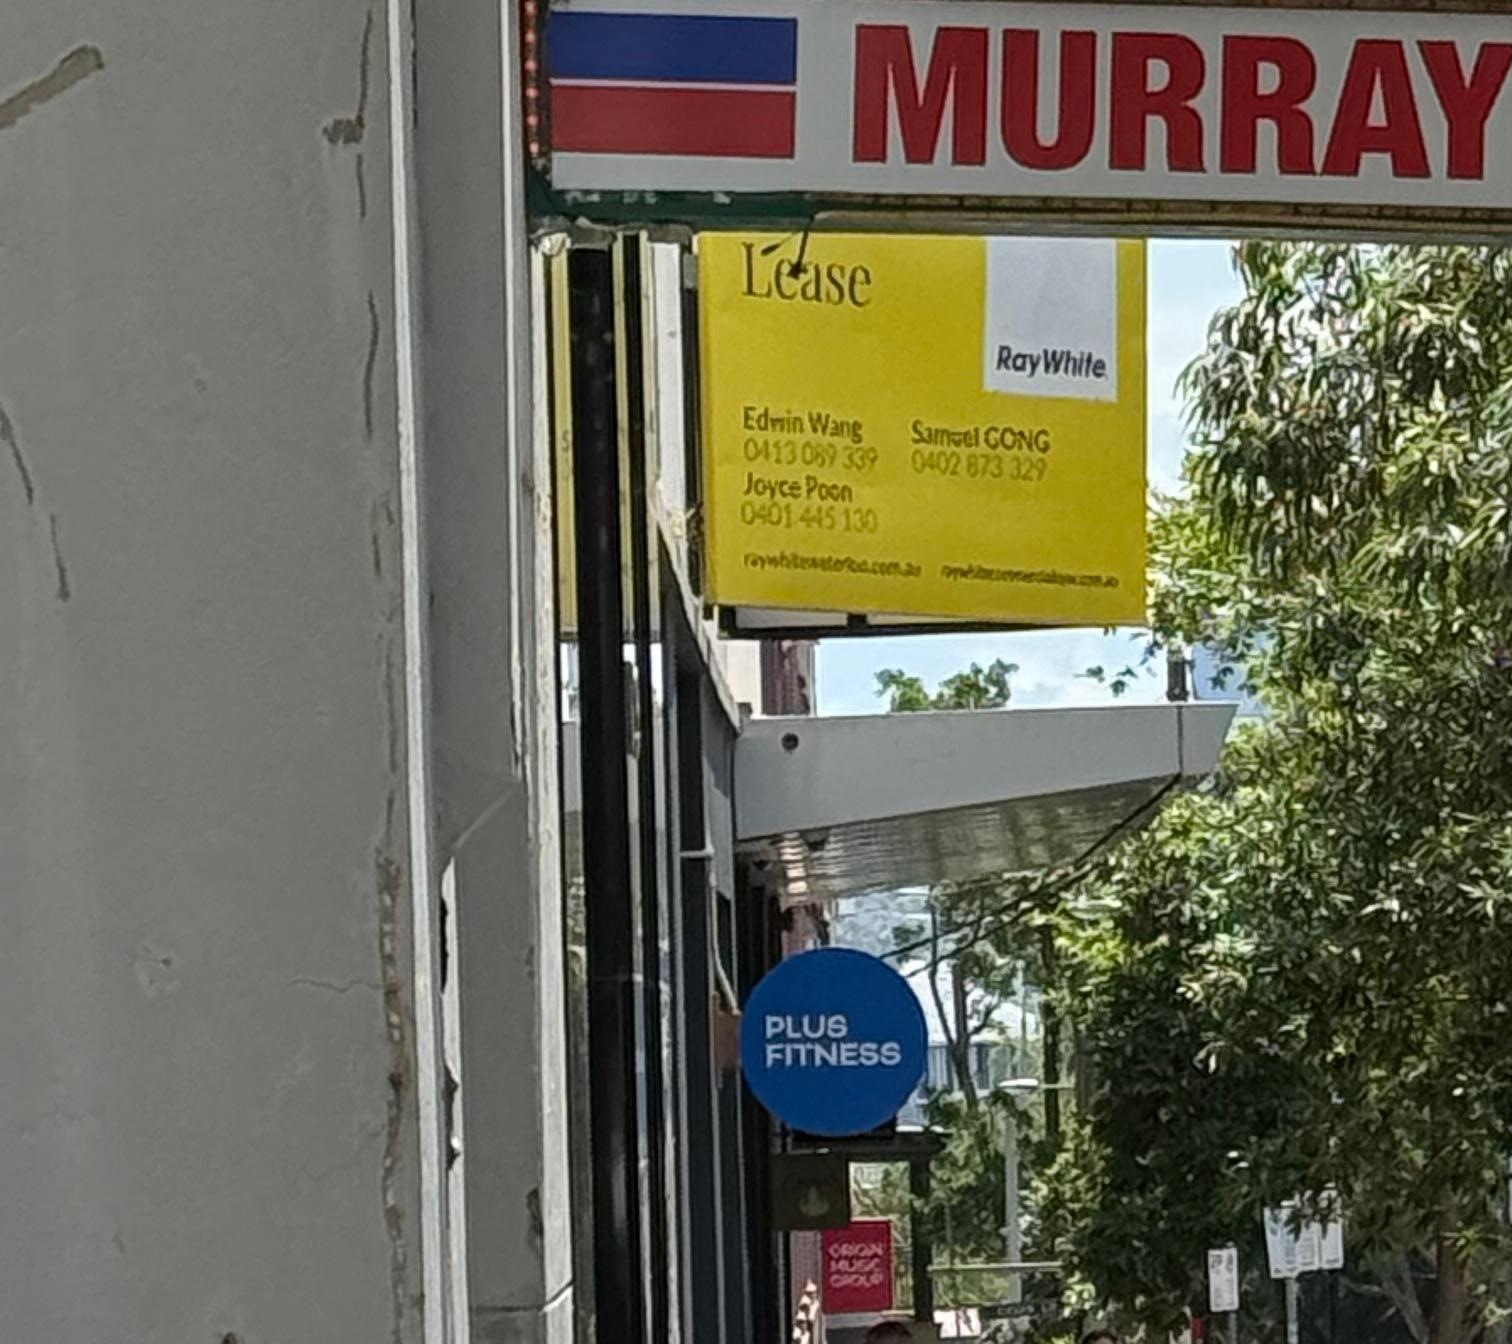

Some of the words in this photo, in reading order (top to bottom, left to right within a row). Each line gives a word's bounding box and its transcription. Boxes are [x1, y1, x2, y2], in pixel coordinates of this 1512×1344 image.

[741, 242, 872, 308] Lease
[743, 406, 805, 434] Edwin
[808, 411, 863, 445] Wang
[911, 419, 980, 448] Samuel
[983, 425, 1051, 454] GONG
[743, 472, 802, 501] Joyce
[805, 474, 853, 503] Poon
[765, 1014, 848, 1039] PLUS
[765, 1042, 902, 1068] FITNESS
